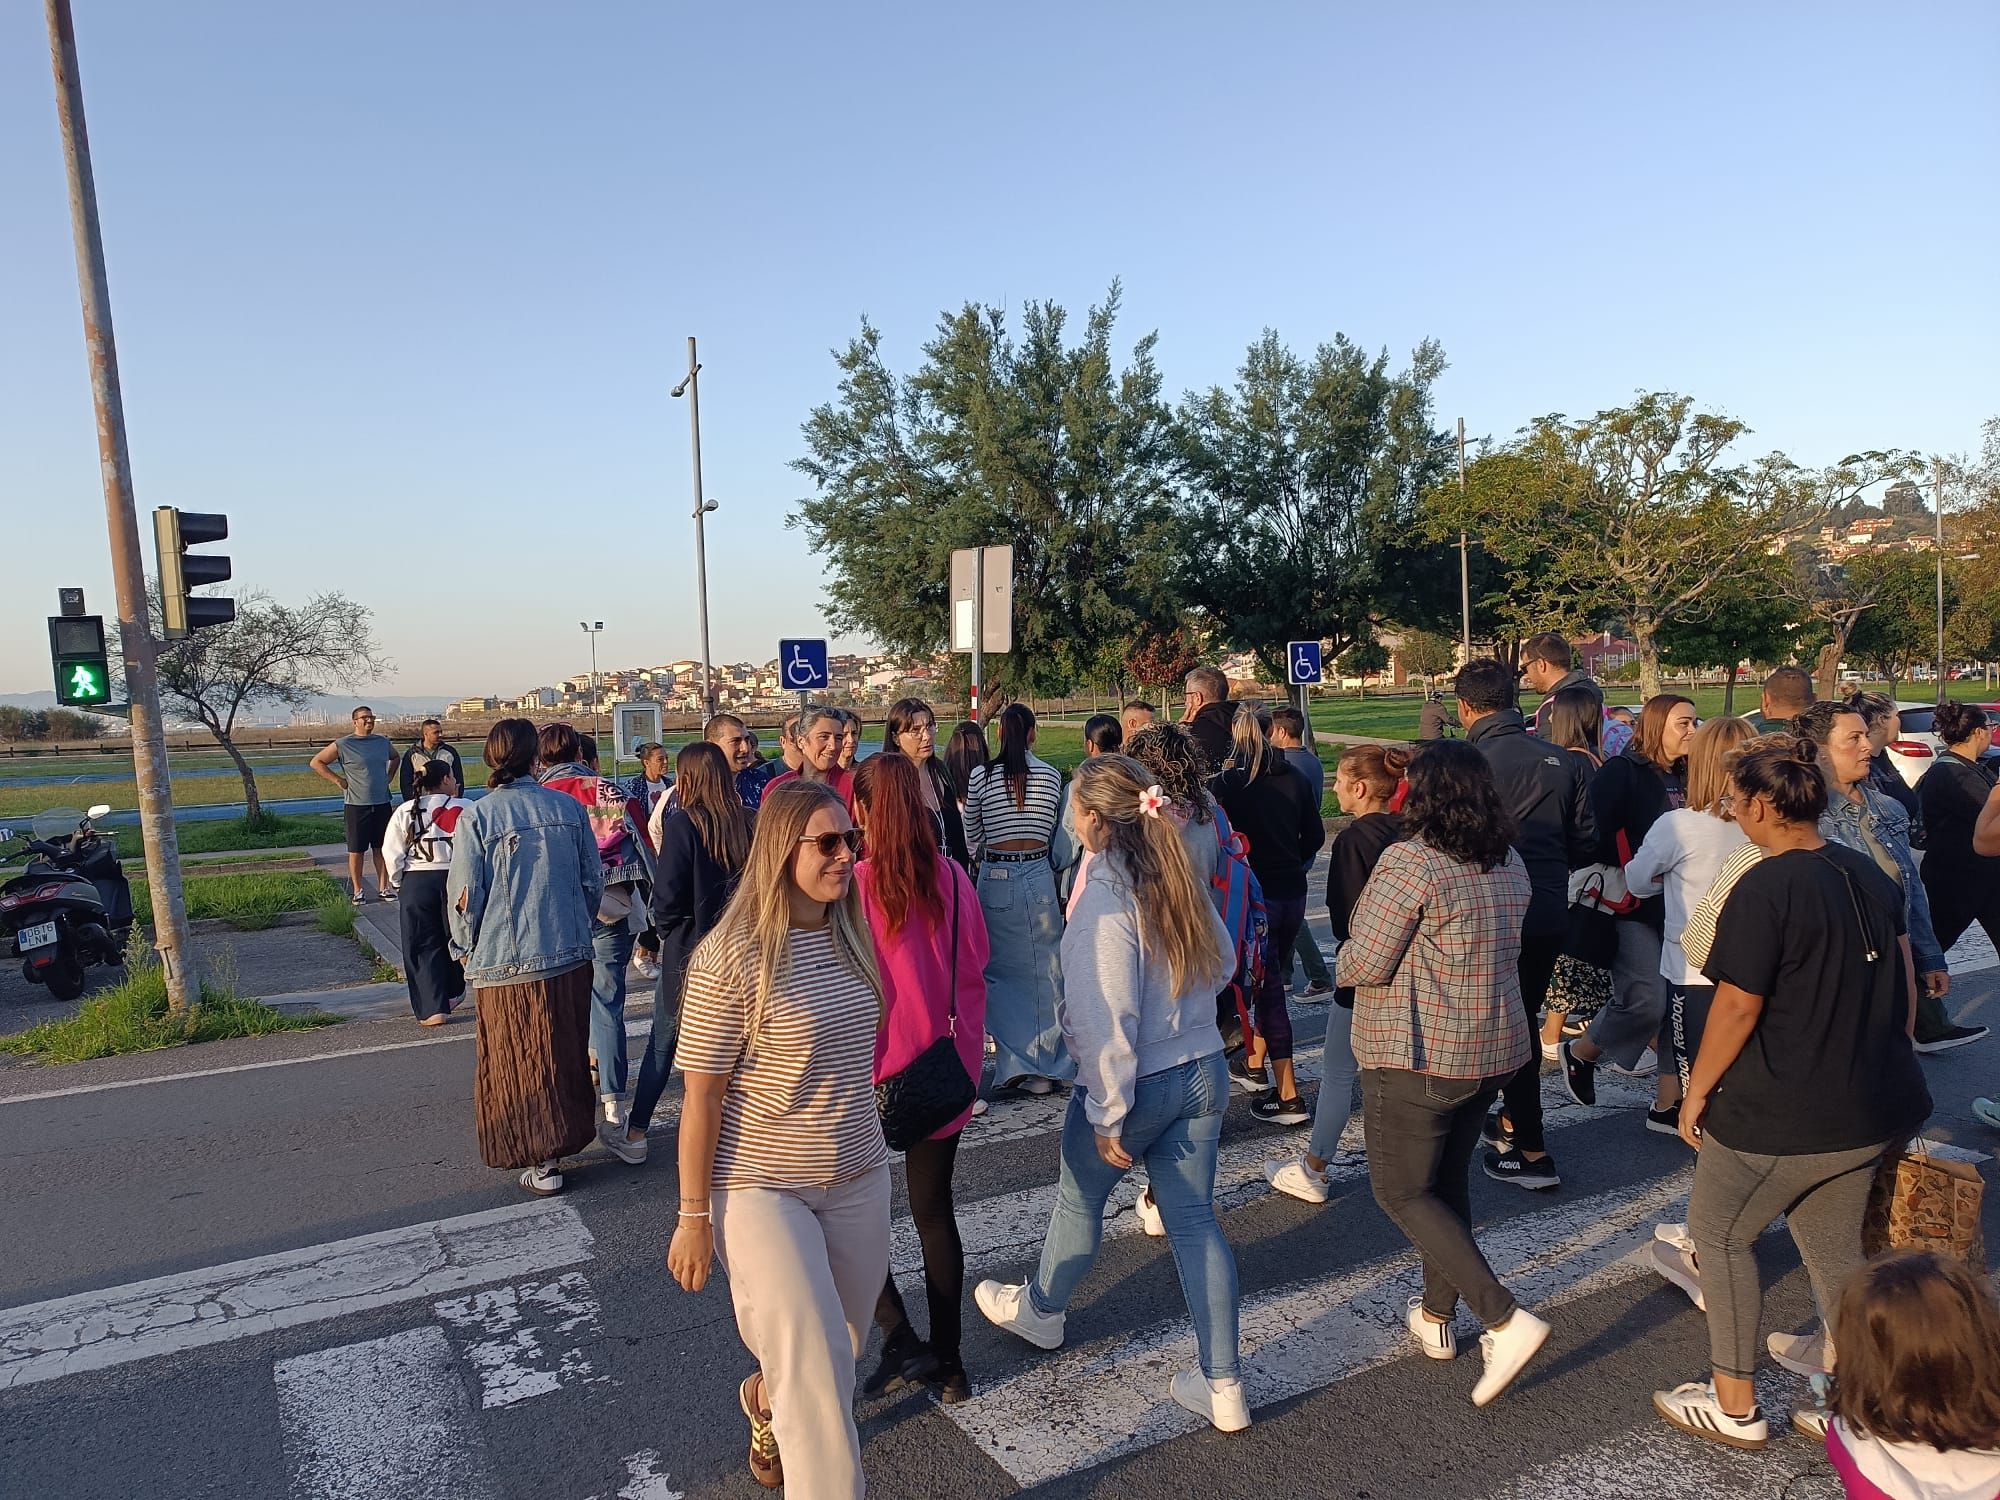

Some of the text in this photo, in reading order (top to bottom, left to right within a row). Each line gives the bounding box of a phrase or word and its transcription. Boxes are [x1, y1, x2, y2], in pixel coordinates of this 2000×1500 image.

[28, 933, 48, 947] LNW
[1671, 992, 1690, 1098] eebok Reebok
[1262, 1102, 1280, 1110] HOKA
[1498, 1160, 1520, 1170] HOKA
